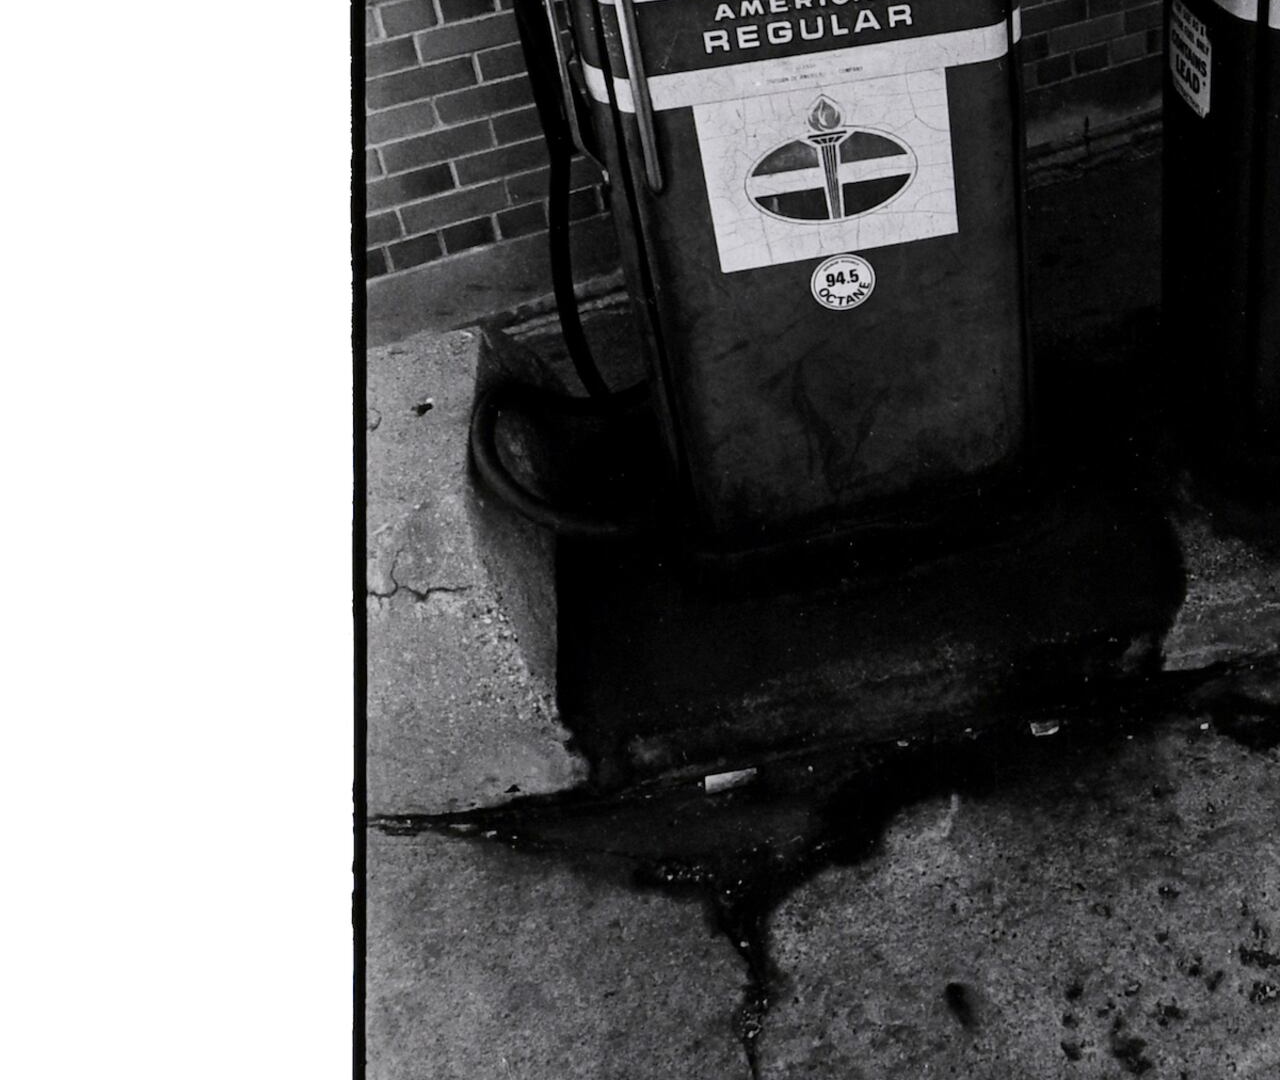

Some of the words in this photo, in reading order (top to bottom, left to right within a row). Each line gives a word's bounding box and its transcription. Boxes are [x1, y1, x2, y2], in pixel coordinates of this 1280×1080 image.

[703, 4, 913, 54] REGULAR
[1172, 28, 1207, 78] CONTAINS
[1175, 54, 1200, 94] LEAD
[819, 281, 870, 306] OCTANE
[826, 268, 859, 287] 94.5
